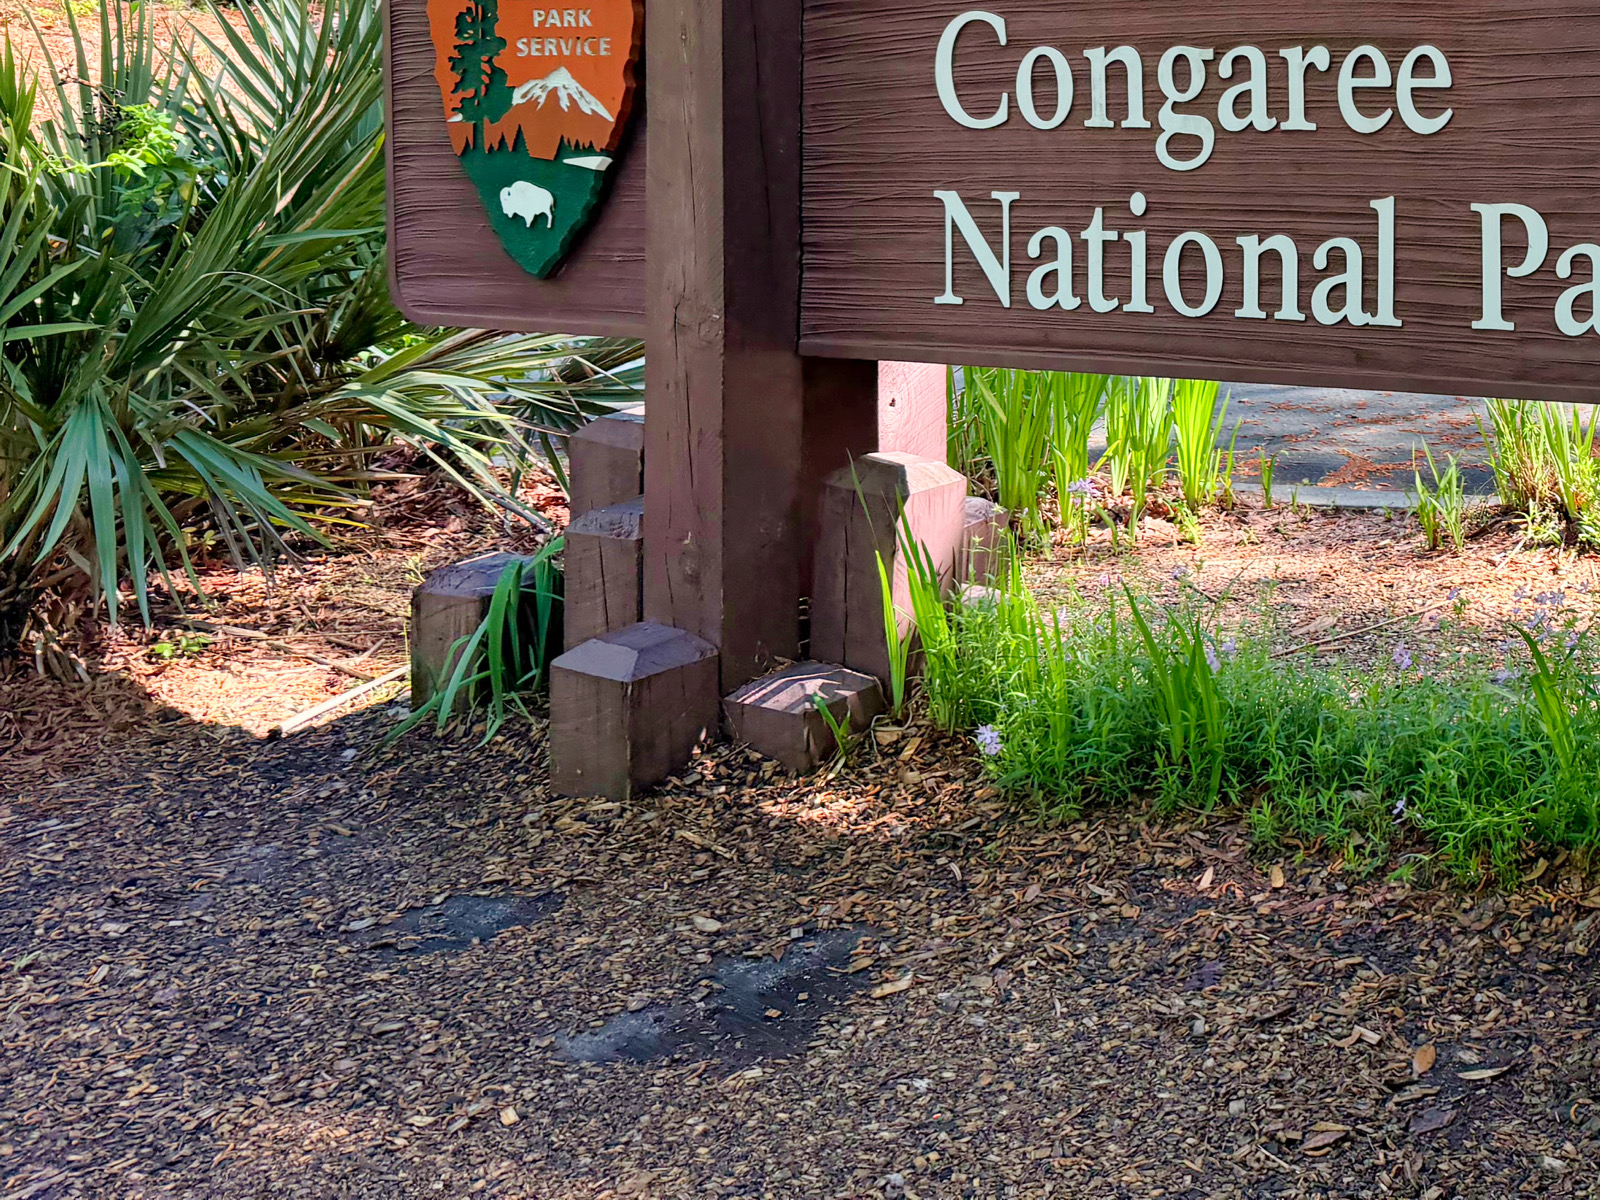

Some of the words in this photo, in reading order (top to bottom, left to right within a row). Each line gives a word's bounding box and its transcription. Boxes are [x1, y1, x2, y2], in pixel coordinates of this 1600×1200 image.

[515, 36, 612, 57] SERVICE
[532, 8, 593, 28] PARK
[934, 10, 1455, 172] Congaree
[932, 189, 1403, 328] National
